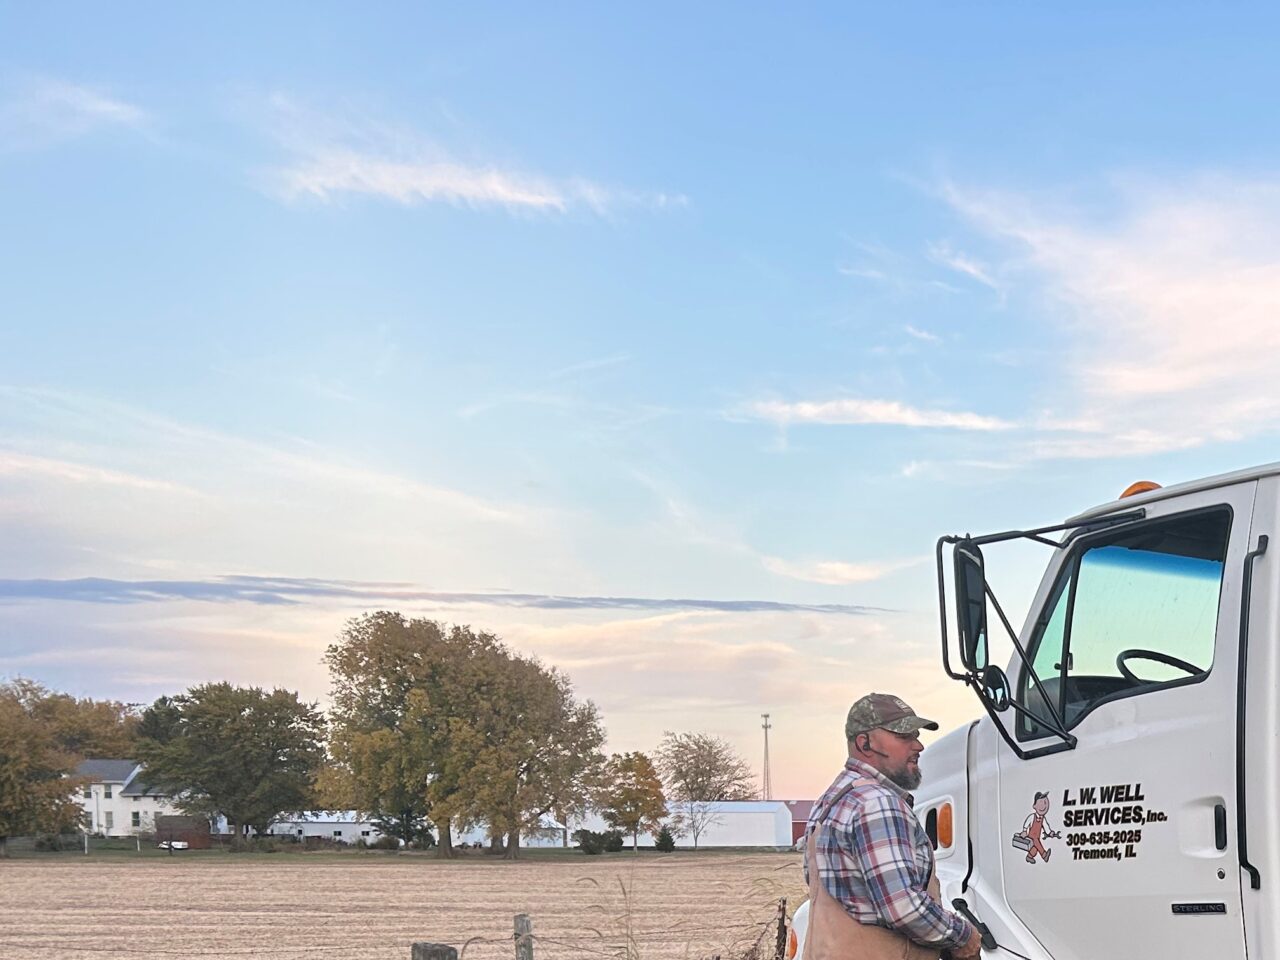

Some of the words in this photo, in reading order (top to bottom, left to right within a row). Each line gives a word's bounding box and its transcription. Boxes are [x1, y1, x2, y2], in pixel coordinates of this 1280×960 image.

[1062, 789, 1076, 806] L.
[1080, 787, 1097, 805] W.
[1100, 783, 1145, 804] WELL
[1063, 805, 1146, 827] SERVICES,
[1146, 810, 1168, 822] Inc.
[1066, 829, 1142, 846] 309-635-2025
[1072, 845, 1122, 861] Tremont,
[1125, 844, 1136, 858] IL
[1173, 904, 1224, 912] STERLING
